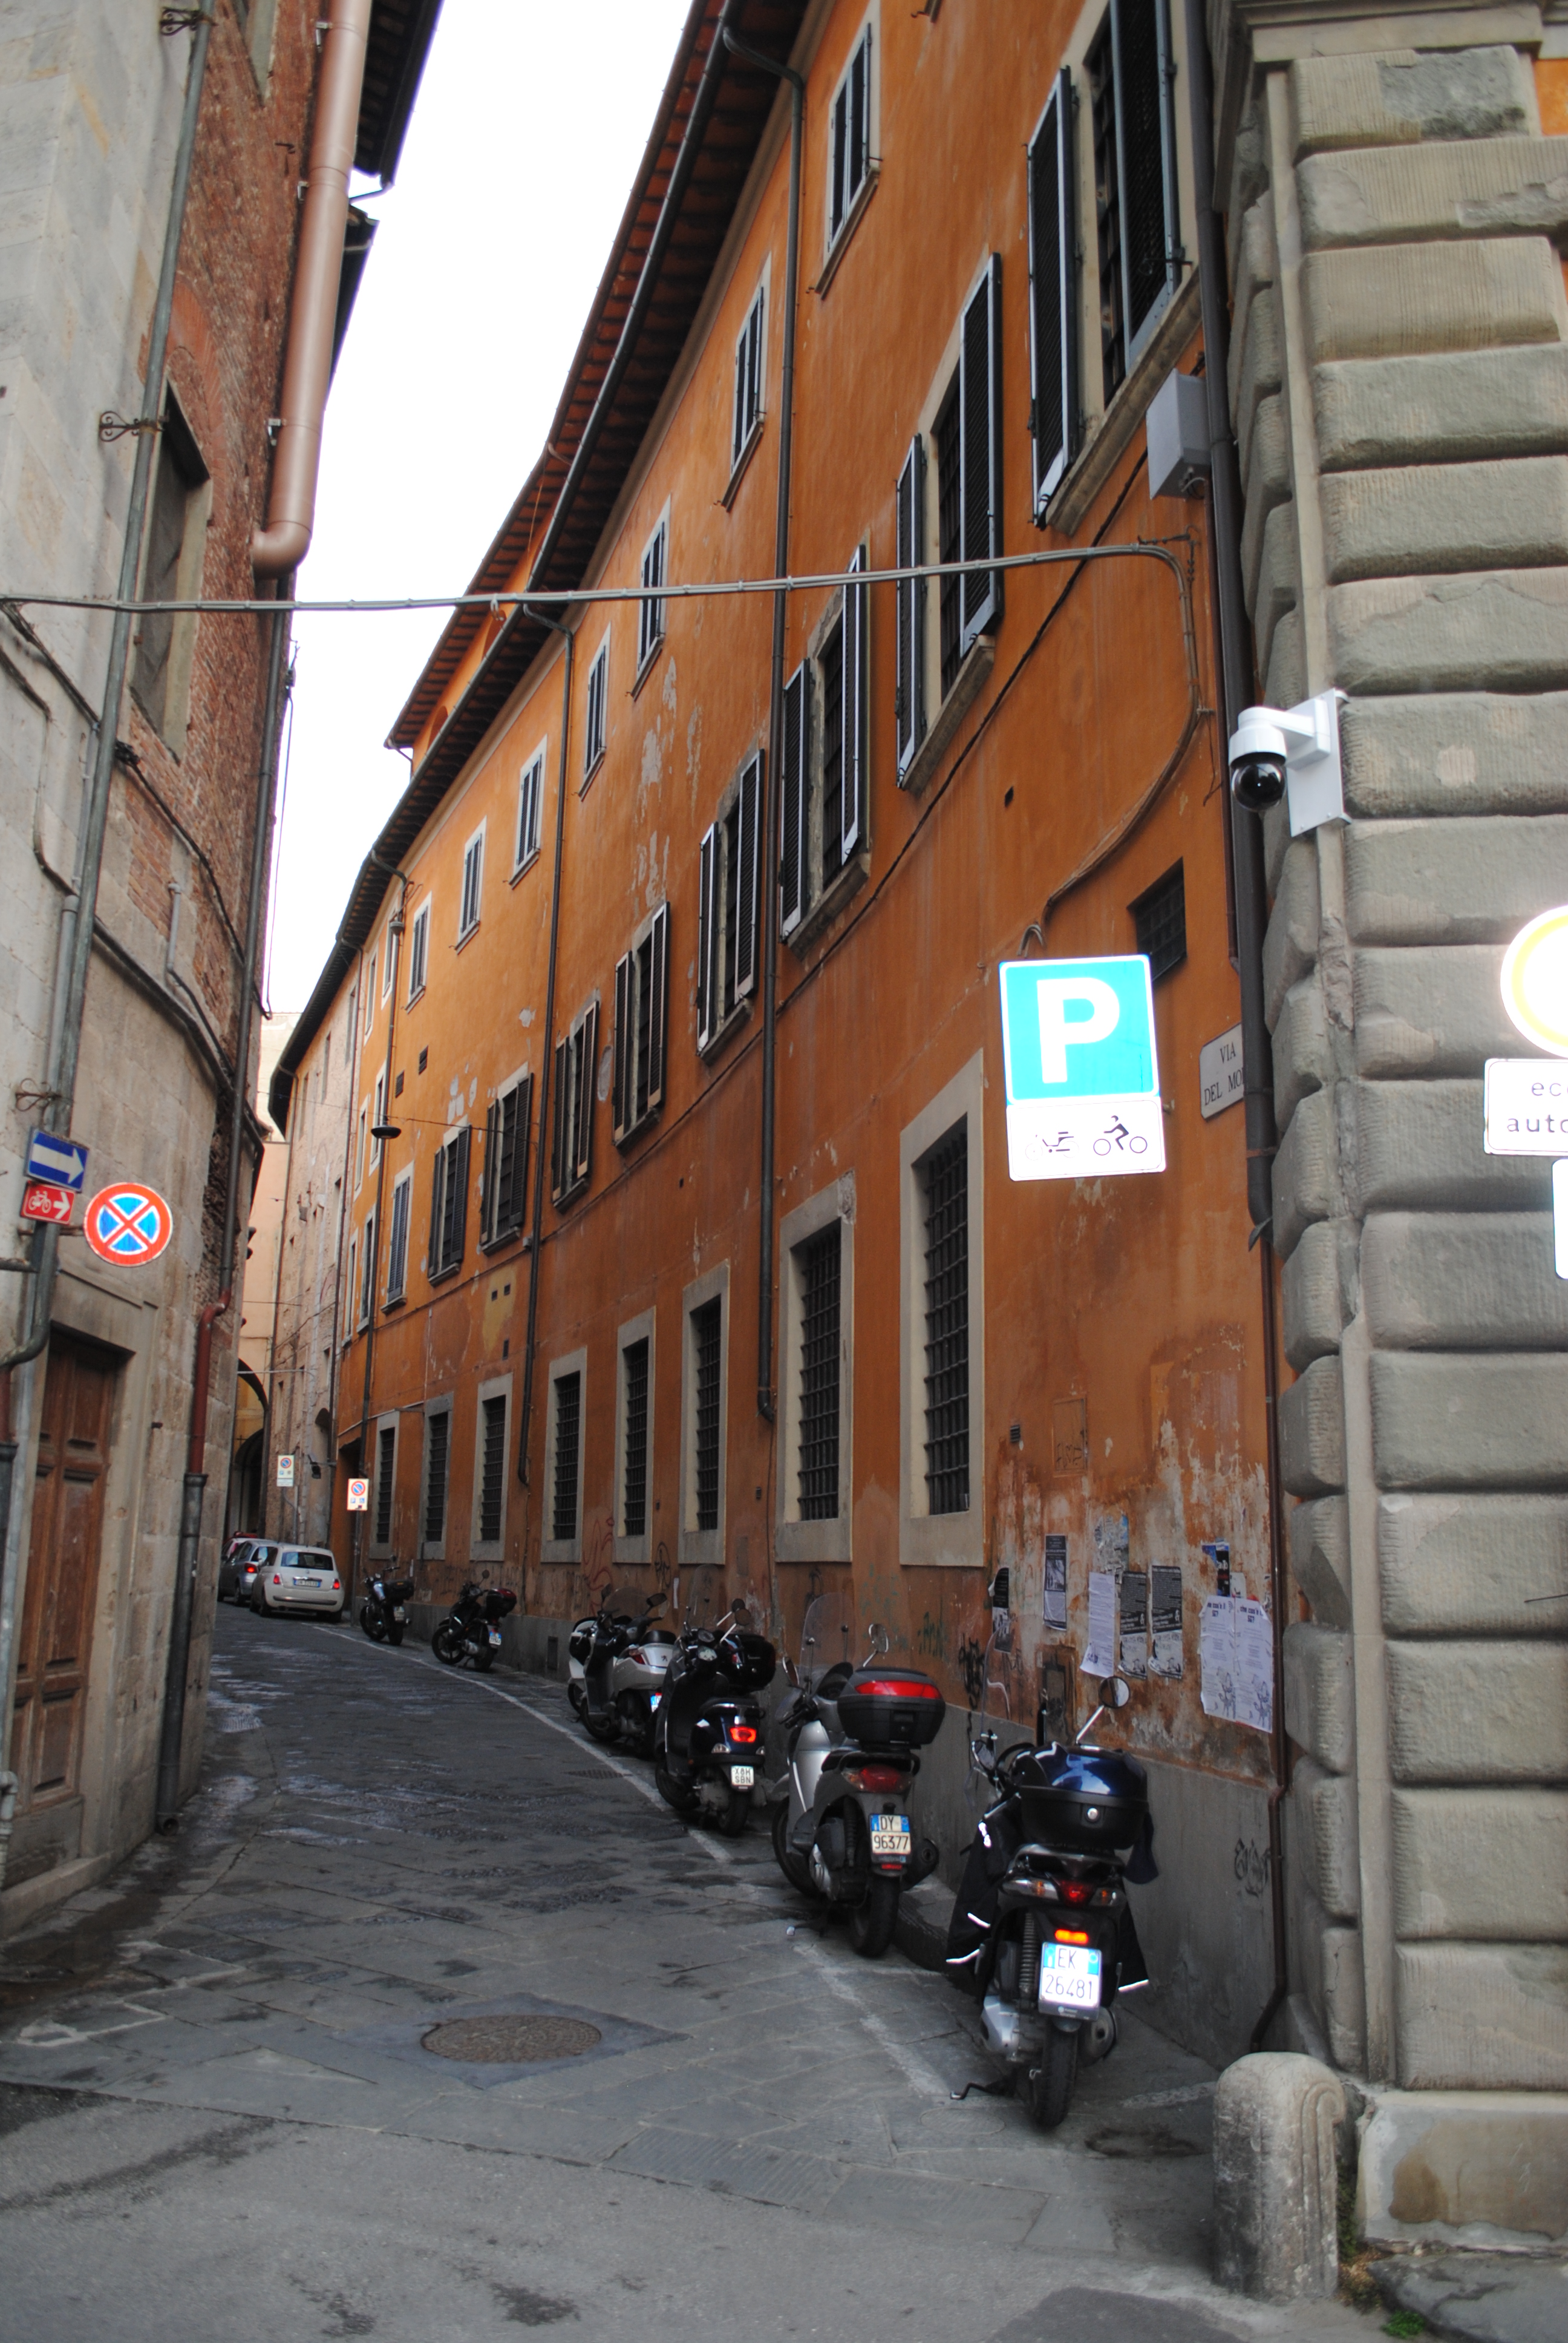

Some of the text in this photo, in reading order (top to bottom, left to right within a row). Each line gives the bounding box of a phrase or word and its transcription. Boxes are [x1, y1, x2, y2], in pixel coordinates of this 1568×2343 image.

[1037, 977, 1120, 1084] P
[1220, 1041, 1236, 1064] VIA
[1204, 1082, 1223, 1106] DEL
[1531, 1082, 1568, 1096] ec
[880, 1816, 894, 1830] DY
[874, 1835, 909, 1850] 96377
[1058, 1948, 1077, 1969] EK
[1045, 1974, 1093, 2000] 26481
